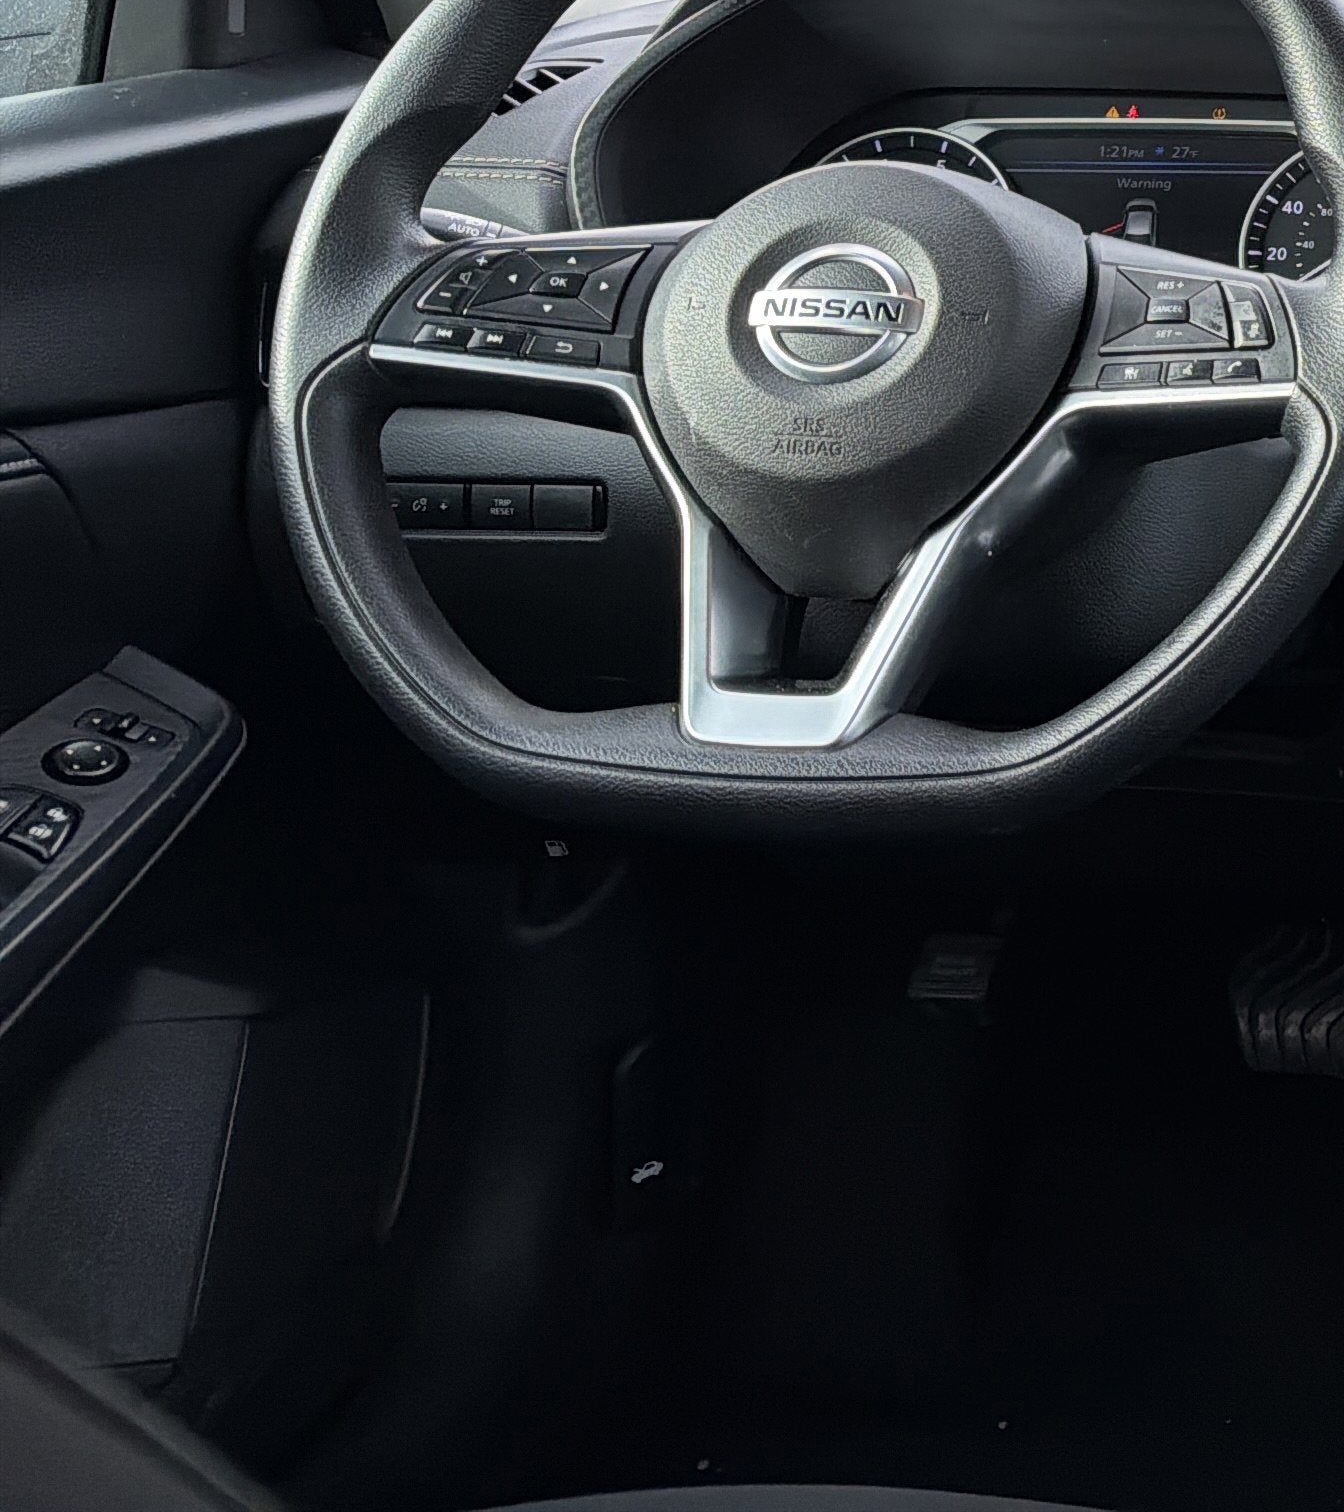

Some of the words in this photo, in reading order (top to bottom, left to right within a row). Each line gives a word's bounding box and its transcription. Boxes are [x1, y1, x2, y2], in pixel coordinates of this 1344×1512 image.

[1116, 177, 1172, 192] Warning
[1281, 200, 1304, 215] 40
[448, 223, 480, 237] AUTO
[1302, 240, 1315, 250] 40
[1266, 247, 1288, 261] 20
[549, 276, 568, 288] OK
[1157, 281, 1175, 290] RES
[763, 297, 905, 325] NISSAN
[1151, 304, 1184, 314] CANCEL
[1155, 329, 1173, 338] SET
[793, 417, 826, 433] SRS
[772, 439, 844, 456] AIRBAG
[493, 498, 512, 506] TRIP
[489, 507, 515, 516] RESET
